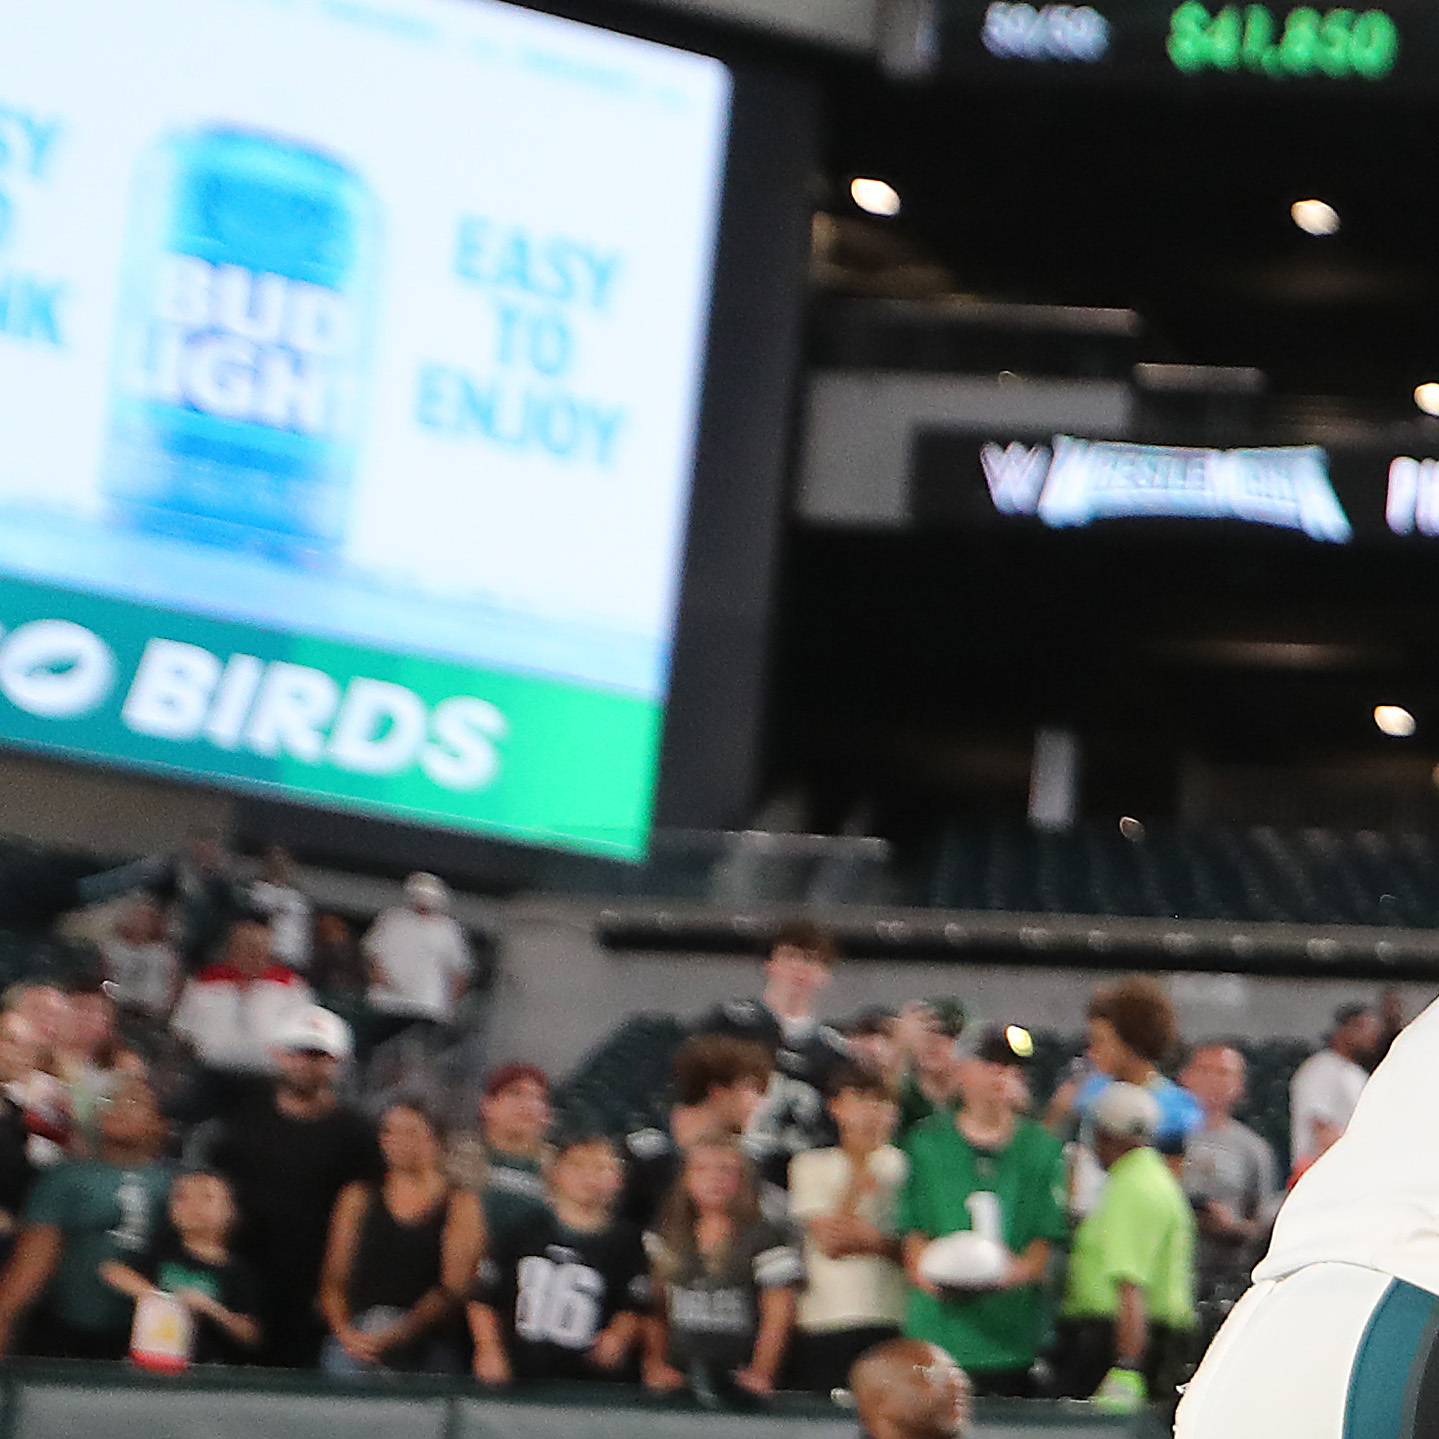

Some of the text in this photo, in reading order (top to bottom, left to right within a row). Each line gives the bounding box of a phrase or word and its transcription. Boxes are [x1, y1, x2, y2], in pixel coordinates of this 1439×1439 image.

[154, 254, 352, 356] BUD
[450, 213, 624, 316] EASY
[490, 293, 577, 380] TO
[412, 358, 626, 470] ENJOY
[120, 636, 507, 792] BIRDS
